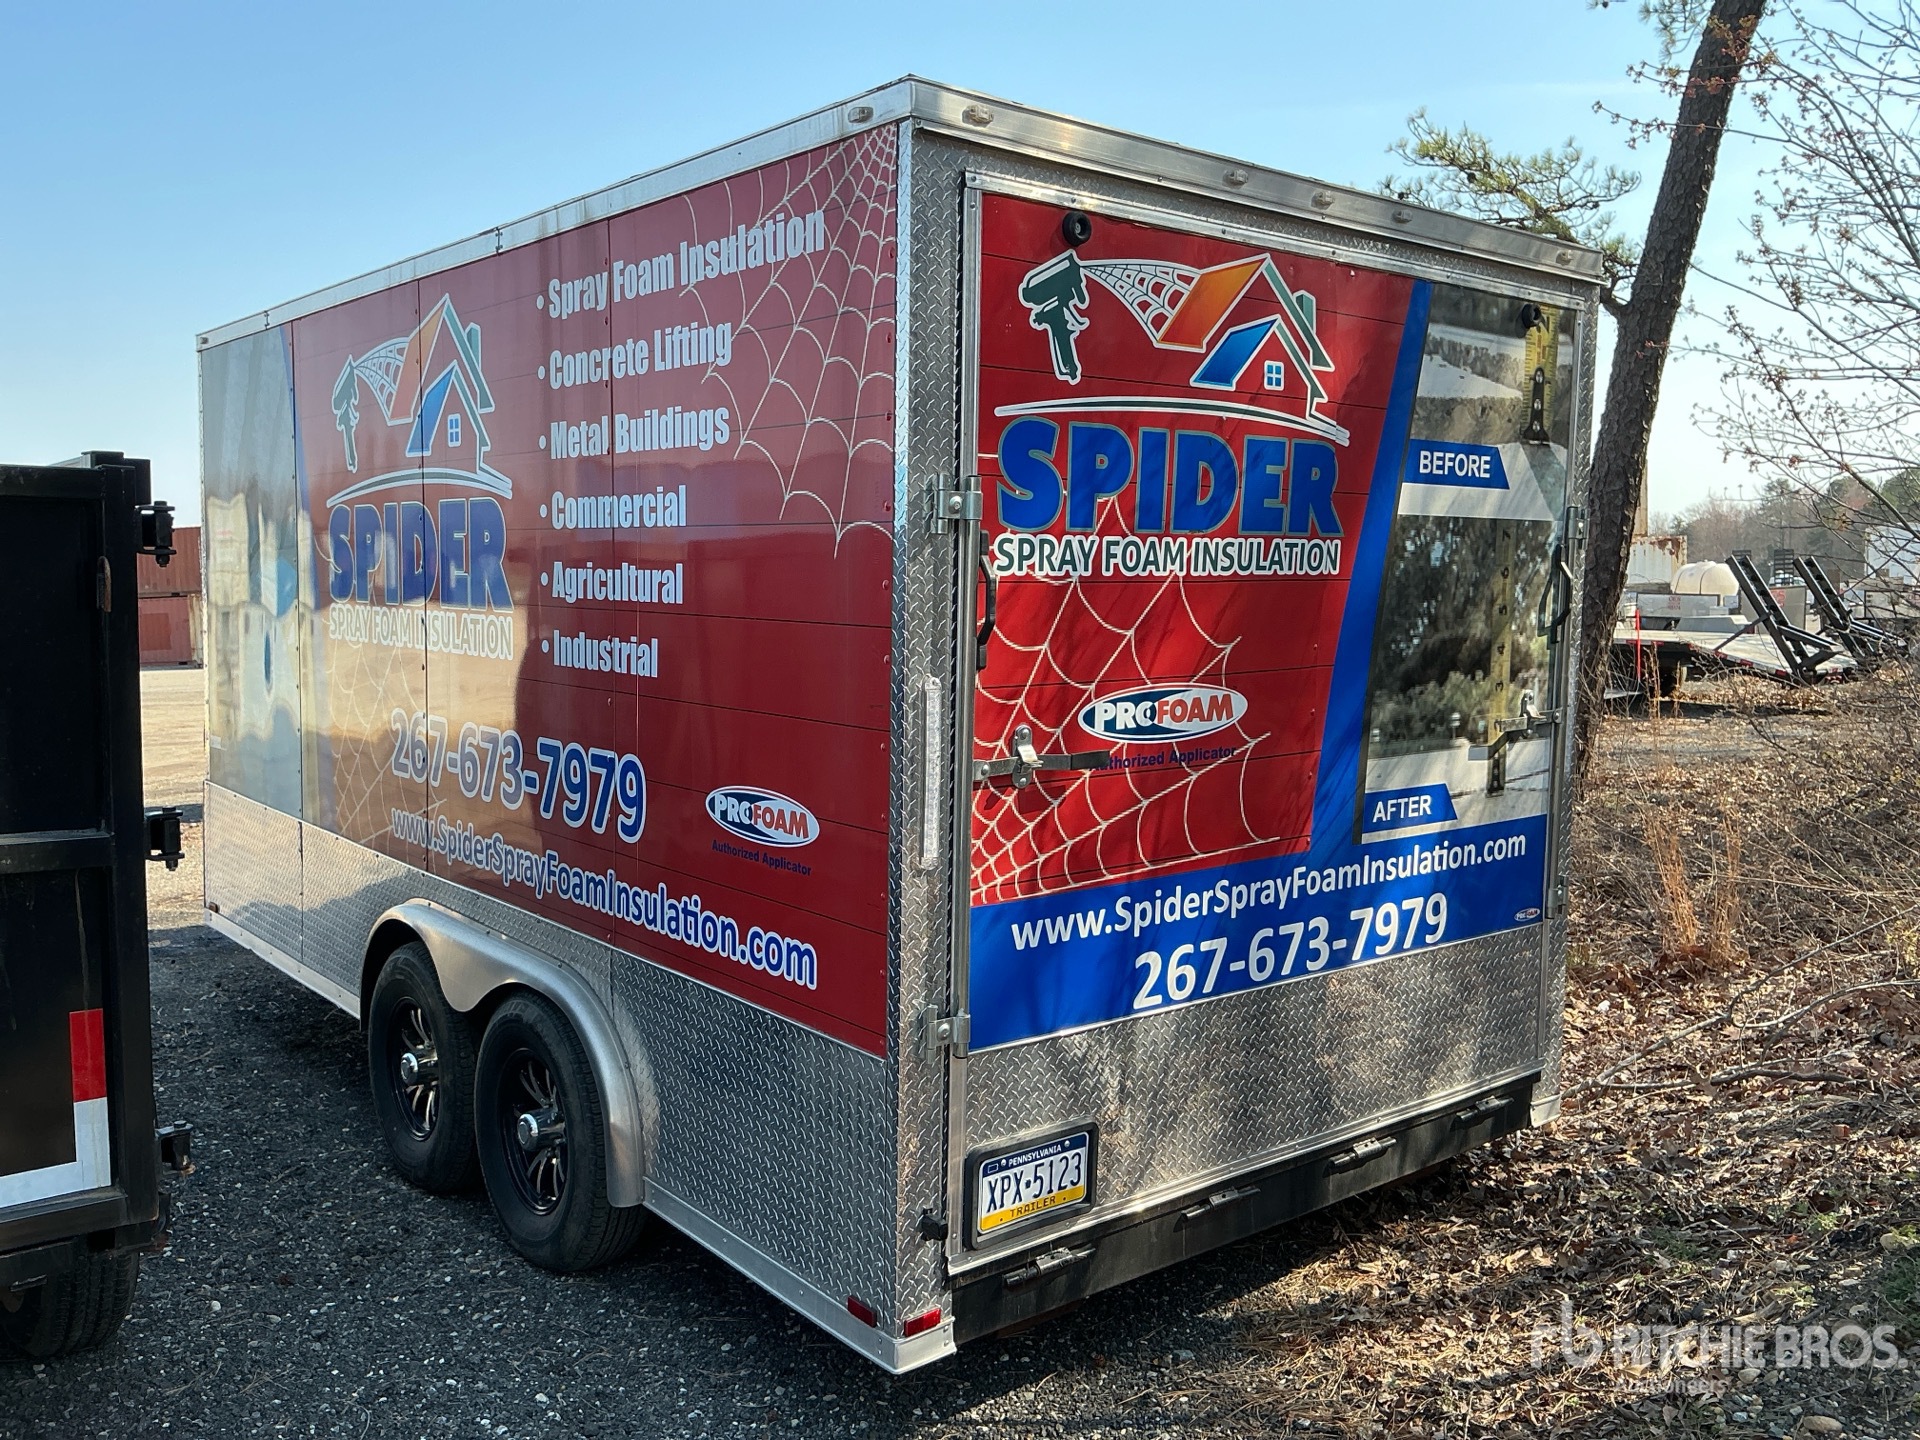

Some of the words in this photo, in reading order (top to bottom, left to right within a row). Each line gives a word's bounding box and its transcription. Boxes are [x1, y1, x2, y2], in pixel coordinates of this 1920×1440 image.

[549, 272, 609, 319] Spray
[613, 252, 674, 302] Foam
[680, 210, 825, 286] Insulation
[550, 338, 649, 390] Concrete
[654, 322, 732, 373] Lifting
[551, 416, 609, 459] Metal
[614, 406, 730, 454] Buildings
[997, 415, 1344, 537] SPIDER
[1420, 450, 1491, 478] BEFORE
[551, 485, 687, 529] Commercial
[329, 497, 514, 613] SPIDER
[994, 534, 1099, 576] SPRAY
[1101, 536, 1187, 577] FOAM
[1190, 537, 1341, 576] INSULATION
[552, 561, 683, 604] Agricultural
[330, 604, 371, 642] SPRAY
[372, 606, 413, 648] FOAM
[414, 609, 514, 660] INSULATION
[553, 629, 658, 678] Industrial
[391, 708, 647, 843] 267-673-7979
[1090, 752, 1164, 771] thorized
[1169, 746, 1237, 766] Applicator
[1373, 795, 1432, 823] AFTER
[712, 840, 760, 862] Authorized
[762, 852, 811, 876] Applicator
[391, 808, 818, 990] www.SpiderSprayFoamInsulation.com
[1011, 832, 1526, 951] www.SpiderSprayFoamInsulation.com
[1132, 892, 1448, 1010] 267-673-7979
[1008, 1145, 1062, 1167] PENNSYLVANIA
[1010, 1195, 1056, 1218] TRAILER
